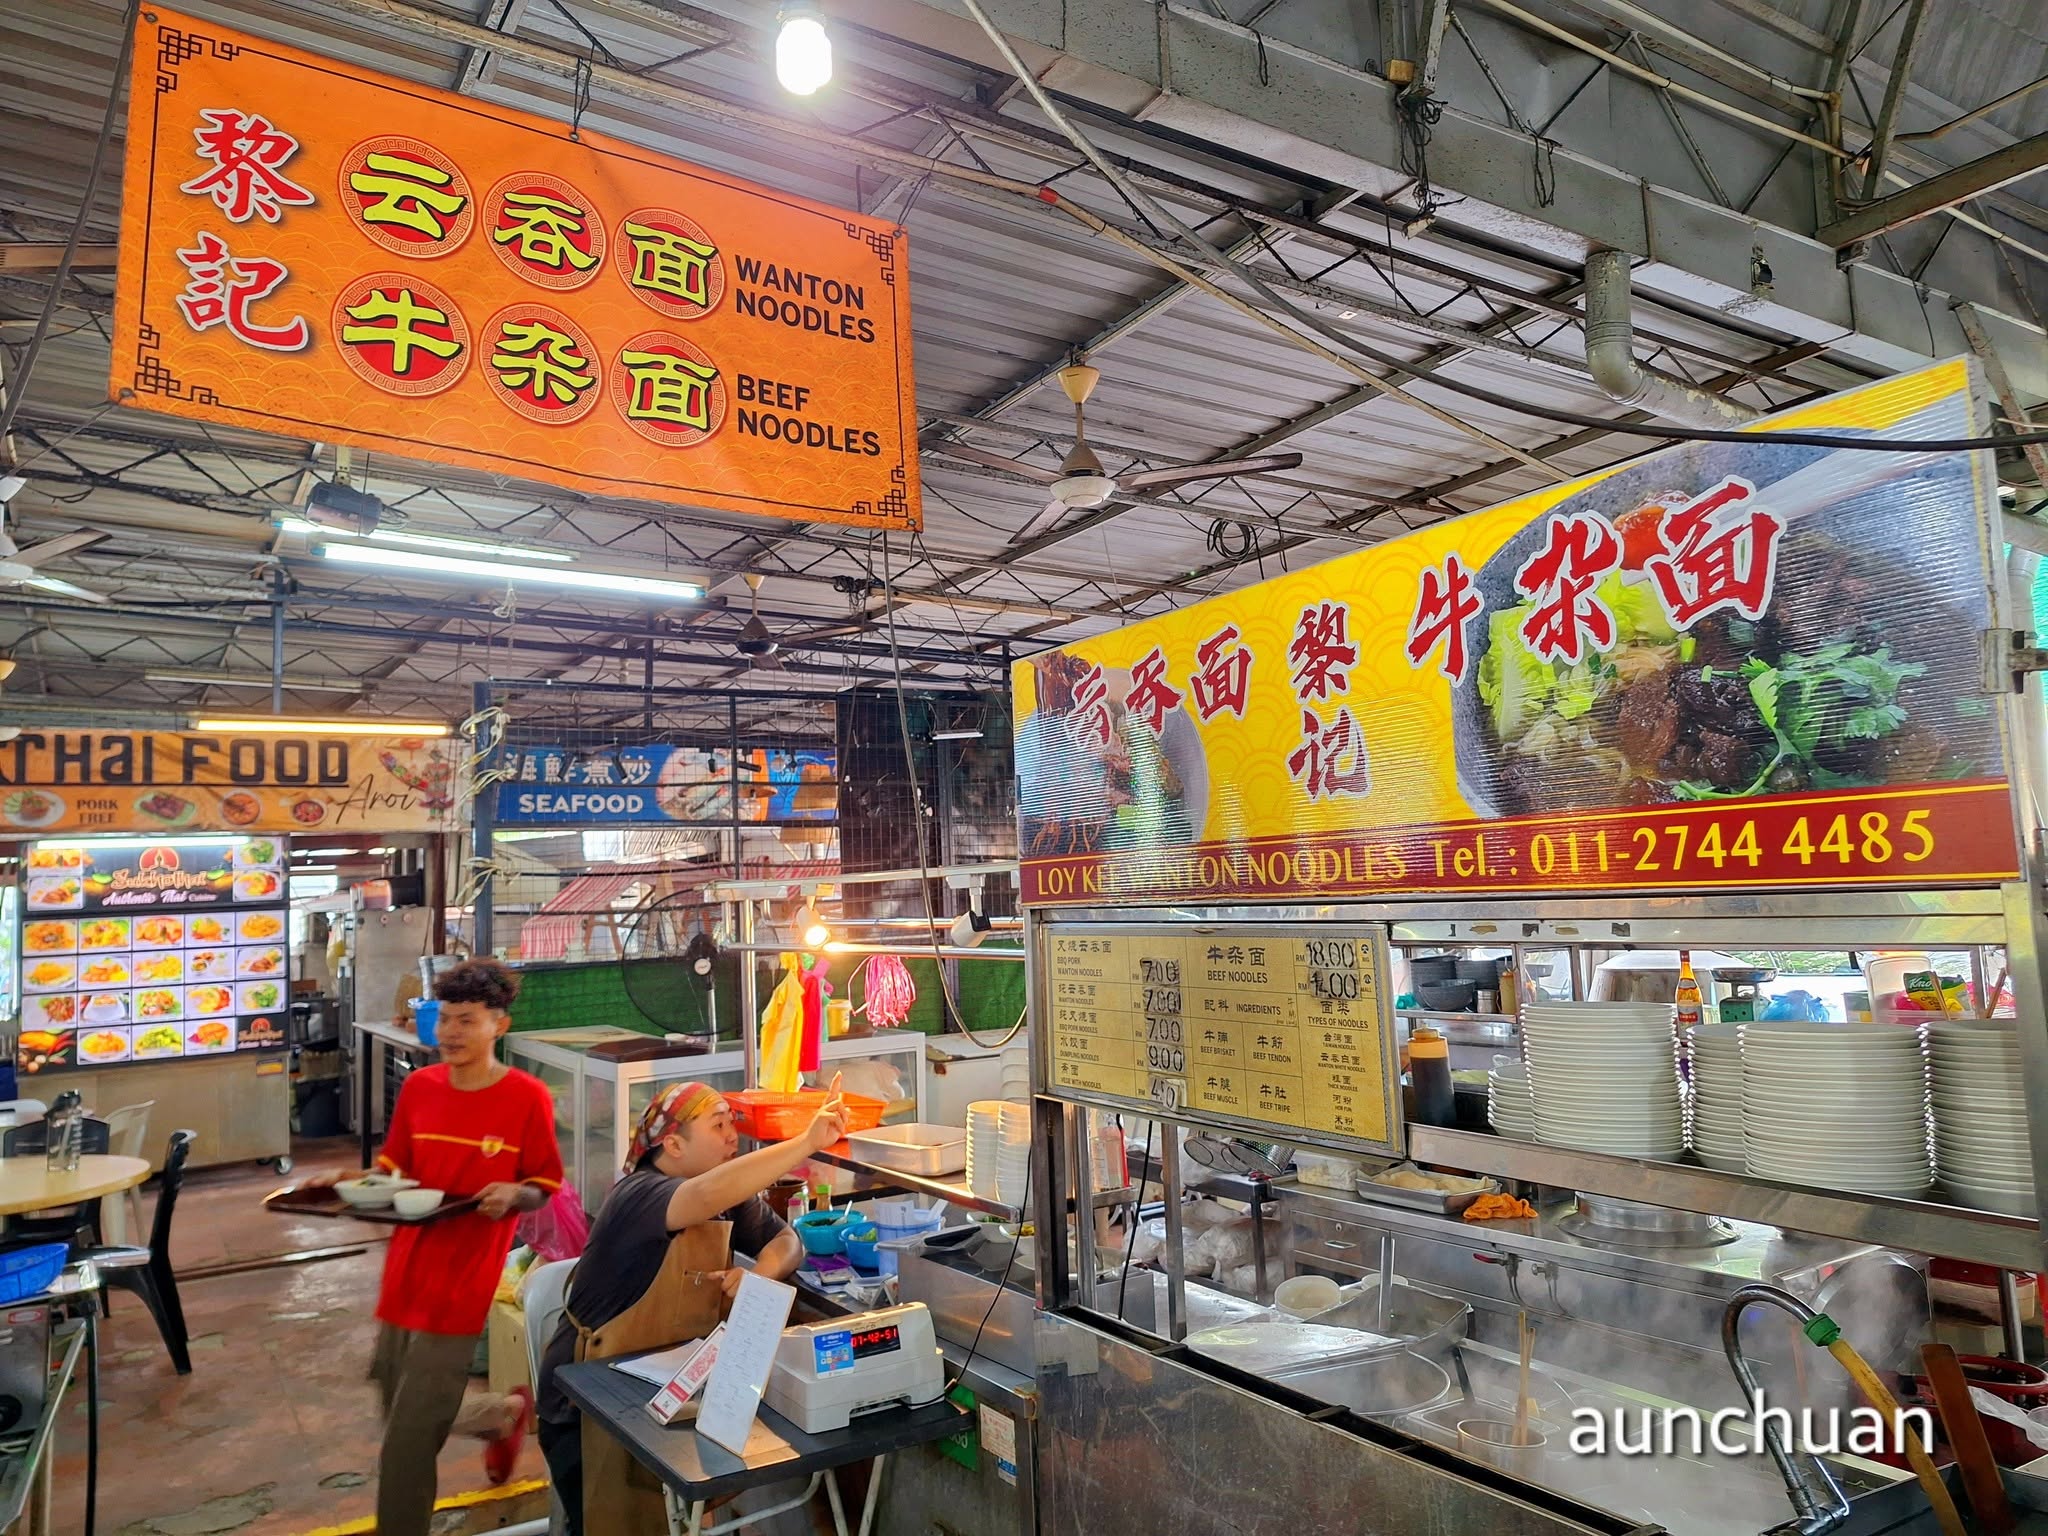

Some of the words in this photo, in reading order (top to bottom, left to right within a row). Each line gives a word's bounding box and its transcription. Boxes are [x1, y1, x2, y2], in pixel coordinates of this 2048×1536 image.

[179, 107, 316, 353] 黎記
[735, 253, 865, 311] WANTON
[735, 290, 876, 345] NOODLES
[343, 289, 719, 434] 牛杂面
[737, 374, 811, 413] BEEF
[737, 410, 882, 458] NOODLES
[182, 739, 349, 784] FOOD
[76, 799, 119, 810] PORK
[518, 793, 644, 814] SEAFOOD
[79, 813, 117, 824] FREE
[1530, 819, 1763, 874] 011-2744
[1782, 809, 1935, 866] 4485
[1037, 868, 1077, 896] LOY
[1249, 844, 1407, 885] NOODLES
[1057, 956, 1067, 966] BBQ
[1068, 956, 1081, 966] PORK
[1207, 944, 1265, 966] 牛杂面
[1295, 954, 1305, 962] RM
[1306, 941, 1354, 968] 18.00
[1057, 968, 1079, 977] WANTON
[1079, 969, 1103, 978] NOODLES
[1207, 970, 1226, 981] BEEF
[1228, 971, 1268, 983] NOODLES
[1236, 1003, 1281, 1016] INGREDIENTS
[1146, 1017, 1181, 1042] 7.00
[1308, 1016, 1328, 1026] TYPES
[1329, 1018, 1337, 1026] OF
[1337, 1019, 1369, 1029] NOODLES
[1060, 1050, 1080, 1058] DUMPLING
[1080, 1053, 1099, 1061] NOODLES
[1148, 1045, 1183, 1072] 9.00
[1200, 1045, 1213, 1054] BEEF
[1214, 1047, 1236, 1056] BRISKET
[1252, 1051, 1266, 1060] BEEF
[1268, 1053, 1292, 1063] TENDON
[1081, 1080, 1101, 1089] NOODLES
[1203, 1092, 1216, 1101] BEEF
[1216, 1094, 1239, 1105] MUSCLE
[1259, 1100, 1273, 1110] BEEF
[1274, 1103, 1291, 1113] TRIPE
